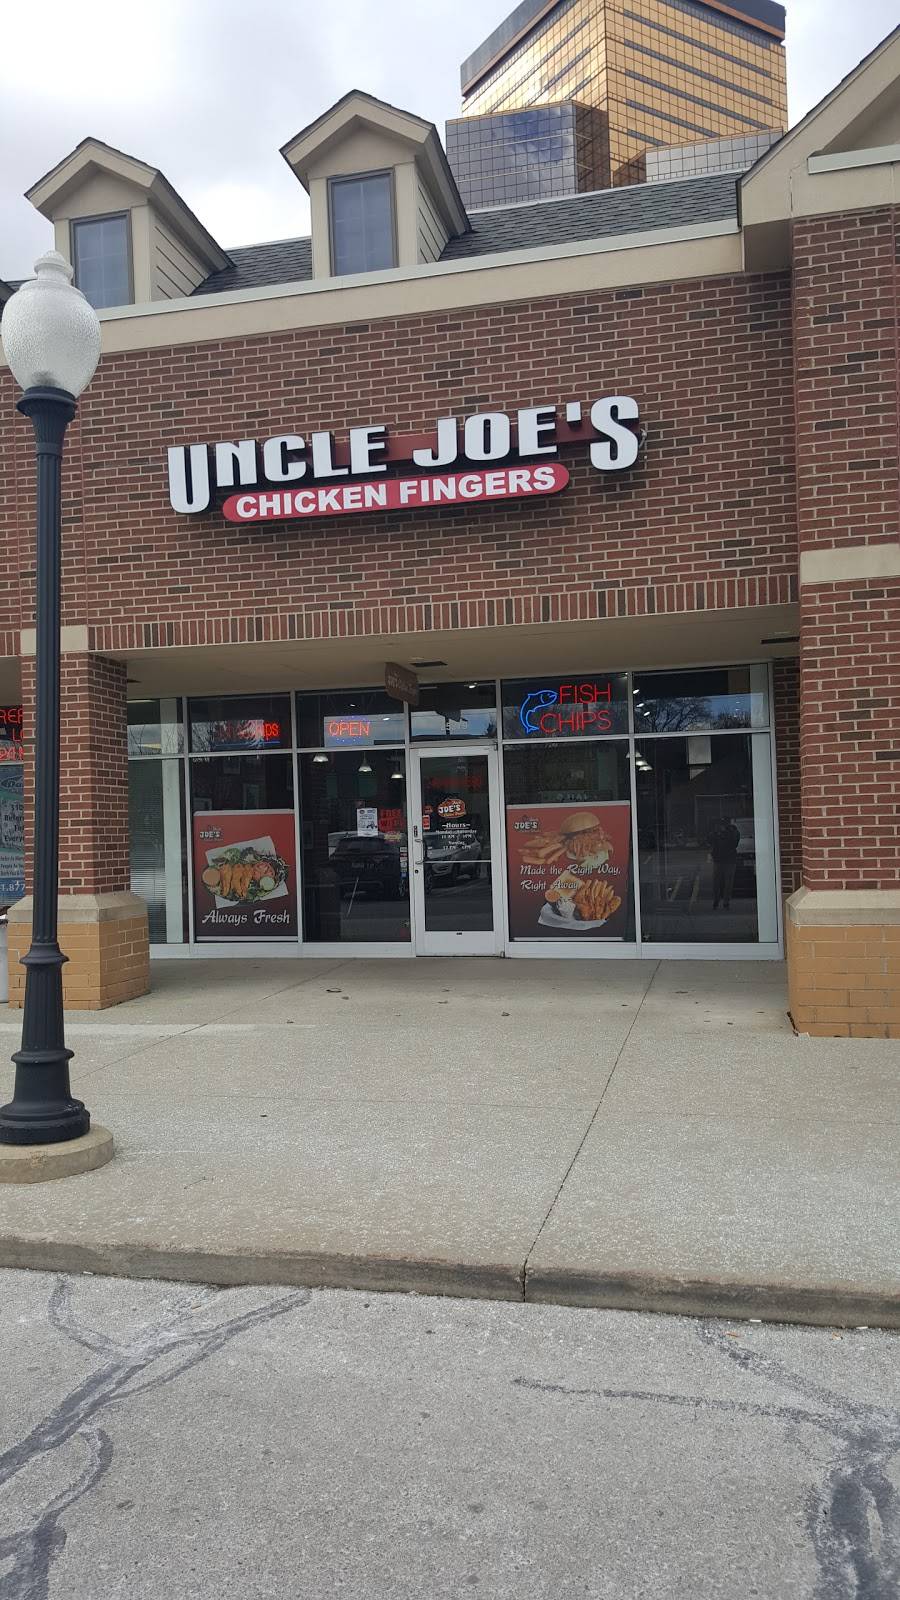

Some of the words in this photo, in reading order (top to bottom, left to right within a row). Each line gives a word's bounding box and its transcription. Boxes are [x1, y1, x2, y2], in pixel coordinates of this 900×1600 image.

[167, 425, 387, 514] UNCLE
[412, 395, 640, 471] JOE'S
[236, 483, 387, 518] CHICKEN
[400, 466, 556, 504] FINGERS
[559, 683, 612, 705] FISH
[328, 720, 371, 737] OPEN
[540, 709, 613, 734] CHIPS
[438, 804, 462, 814] JOE'S
[514, 821, 538, 829] JOE'S
[199, 831, 221, 839] JOE'S
[520, 864, 546, 875] Made
[550, 863, 562, 875] the
[566, 863, 594, 876] Right
[520, 879, 547, 892] Right
[201, 909, 248, 927] Always
[253, 909, 291, 924] Fresh
